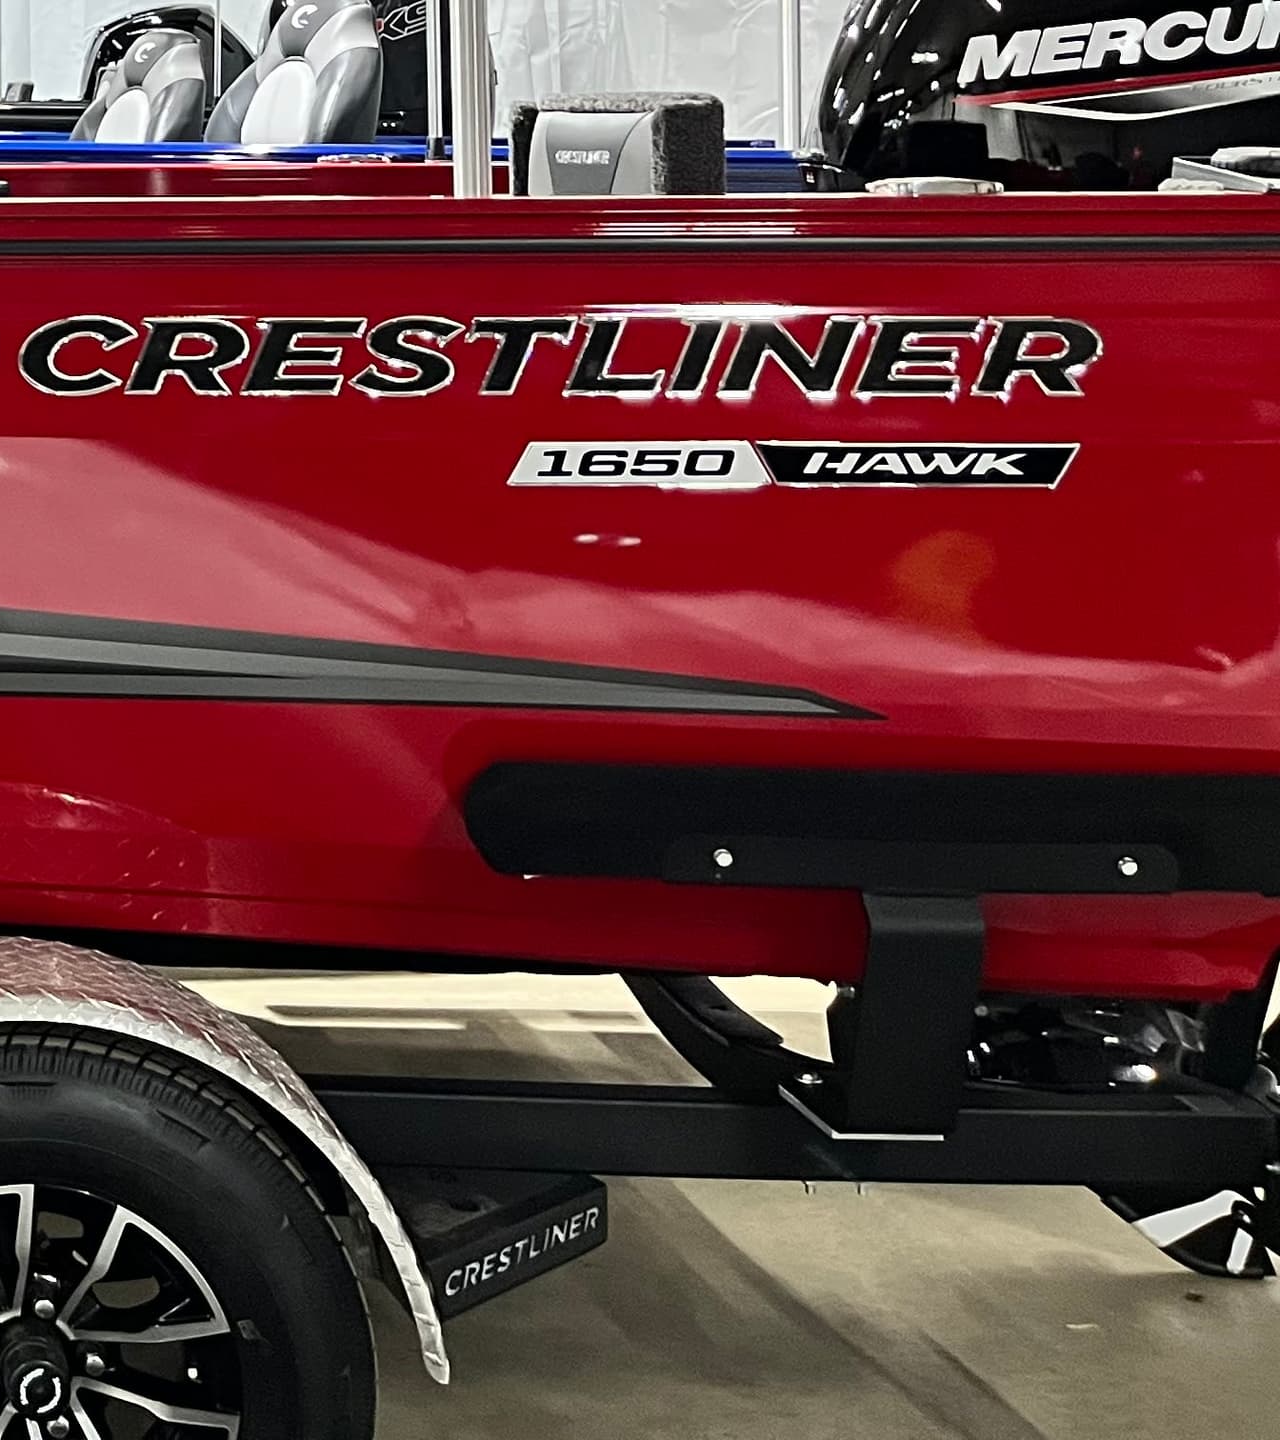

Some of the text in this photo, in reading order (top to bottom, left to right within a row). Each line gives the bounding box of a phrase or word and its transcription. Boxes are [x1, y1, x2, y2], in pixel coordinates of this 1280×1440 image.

[17, 315, 1104, 398] CRESTLINER
[536, 449, 1025, 478] 1650 HAWK
[445, 1207, 600, 1296] CRESTLINER
